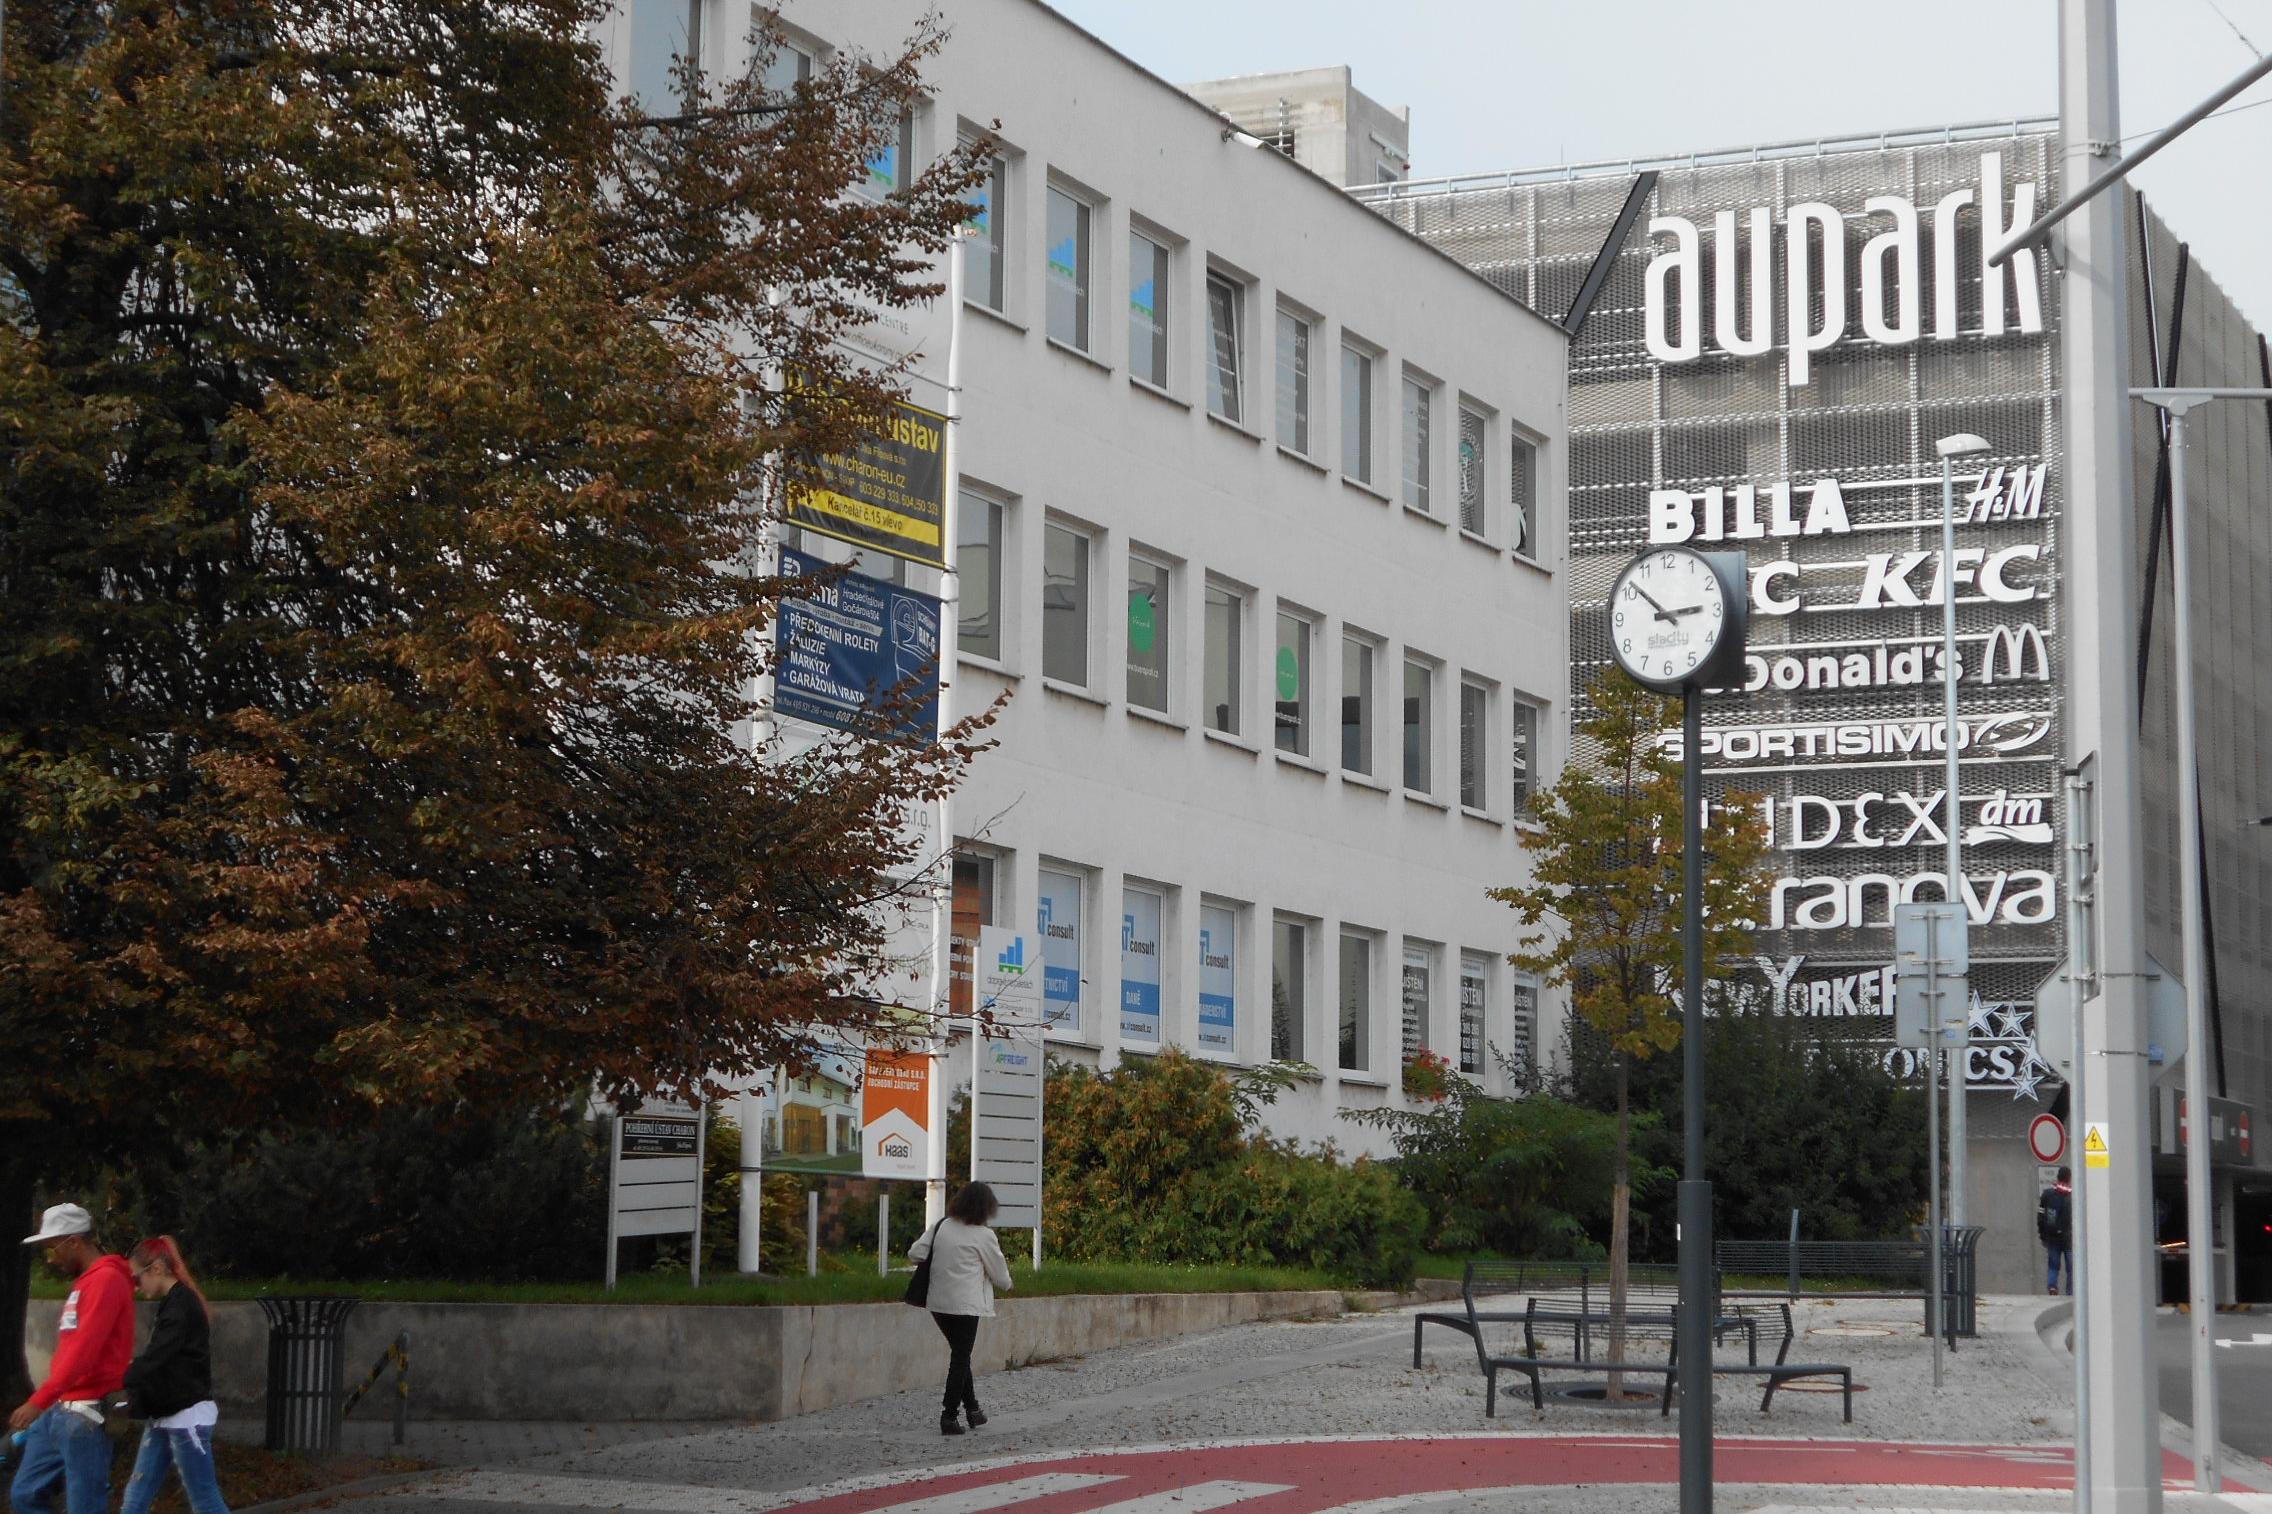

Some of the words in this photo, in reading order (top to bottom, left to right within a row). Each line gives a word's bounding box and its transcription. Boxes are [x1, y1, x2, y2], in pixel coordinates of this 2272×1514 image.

[1645, 152, 2041, 386] aupark
[1965, 463, 2046, 525] H&M
[1649, 478, 1851, 545] BILLA
[1660, 553, 1676, 569] 12
[1688, 559, 1695, 575] 1
[1640, 562, 1651, 579] 11
[1856, 544, 2040, 608] KFC
[1704, 575, 1714, 591] 2
[1622, 585, 1637, 601] 10
[1712, 602, 1722, 618] 3
[1615, 612, 1624, 628] 9
[844, 633, 879, 654] ROLETY
[1623, 638, 1632, 654] 8
[1705, 629, 1714, 646] 4
[790, 650, 832, 676] MARKÝZY
[1640, 655, 1649, 671] 7
[1687, 651, 1697, 667] 5
[1664, 660, 1673, 676] 6
[789, 670, 838, 696] GARÁŽOVÁ
[1656, 721, 1969, 762] SPORTISIMO
[1980, 790, 2042, 825] dm
[1048, 922, 1074, 940] consult
[1130, 938, 1155, 956] consult
[1205, 952, 1230, 969] consult
